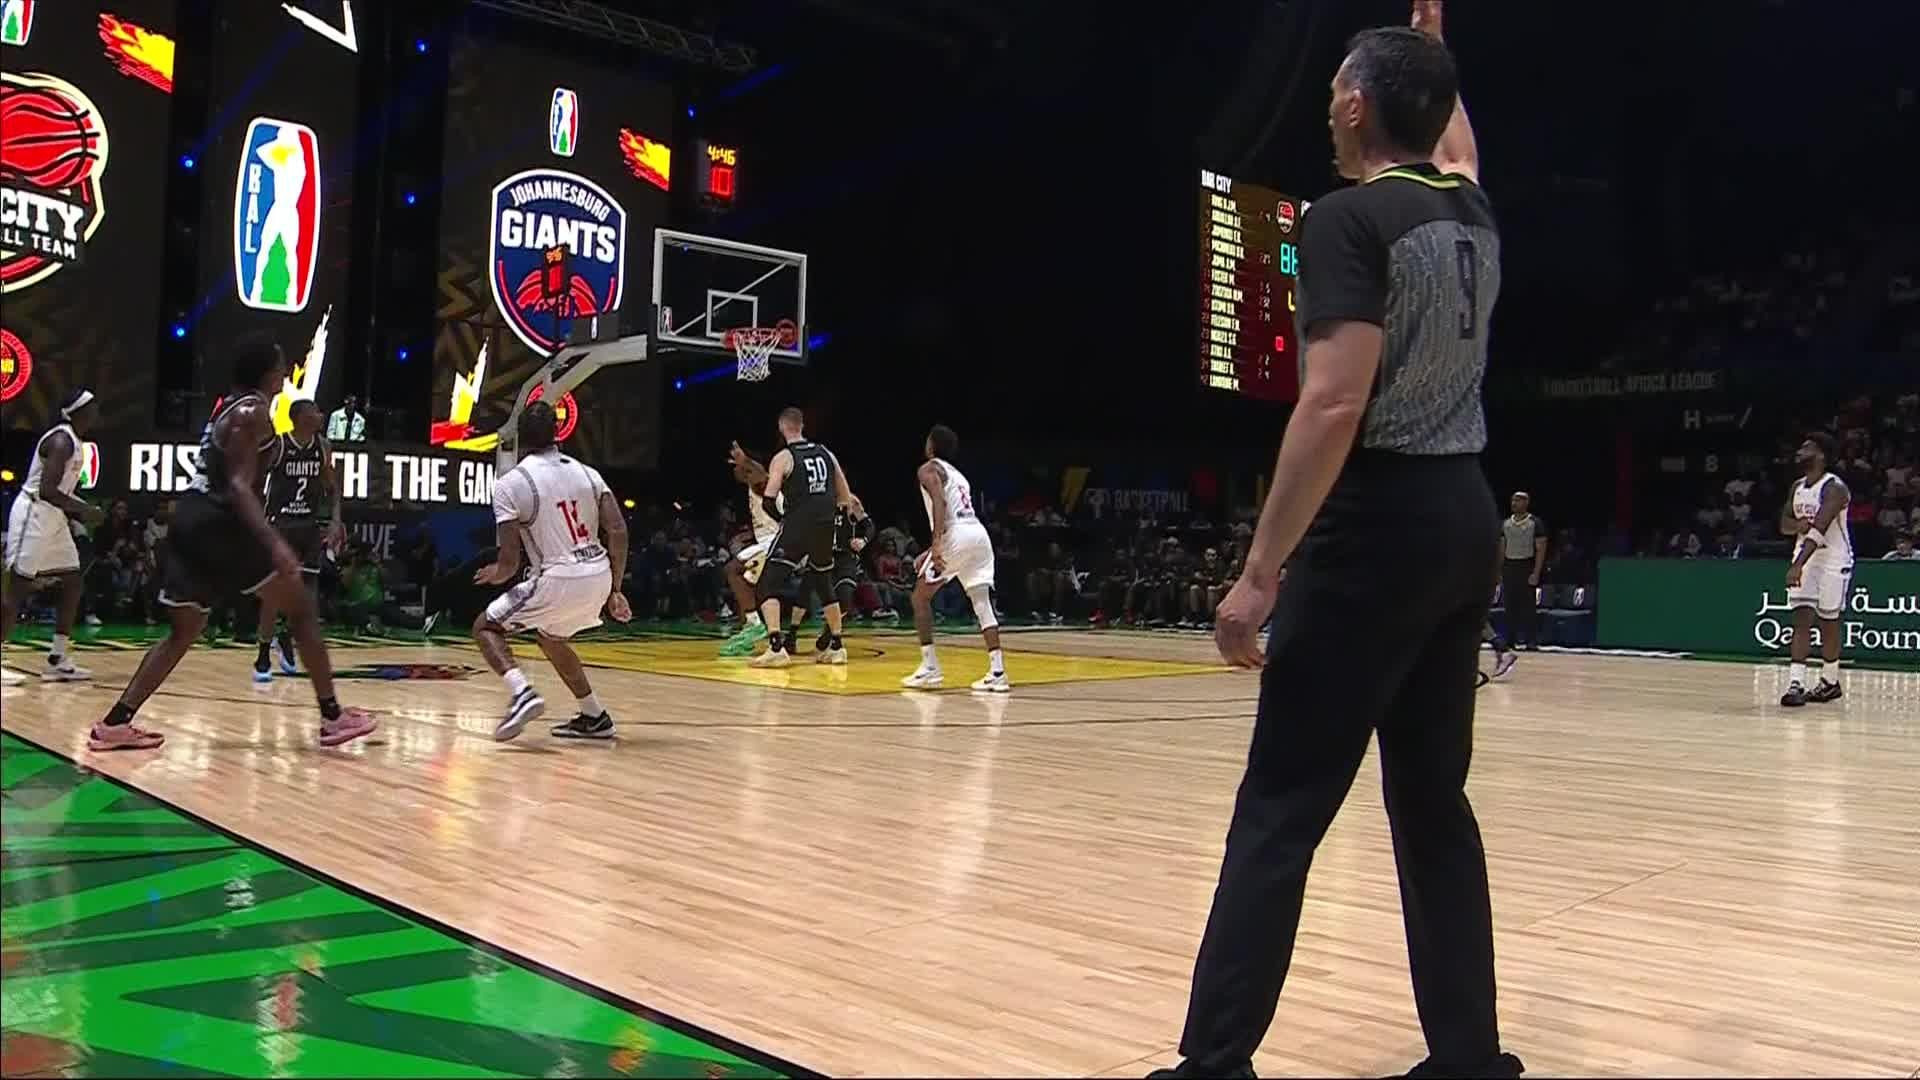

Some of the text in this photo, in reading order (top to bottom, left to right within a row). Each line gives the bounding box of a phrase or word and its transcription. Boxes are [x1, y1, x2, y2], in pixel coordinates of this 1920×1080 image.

[707, 144, 737, 167] 4:46
[0, 187, 84, 242] CITY
[245, 163, 262, 254] BAL
[509, 179, 611, 222] JOHANNESBURG
[0, 227, 77, 260] LL TEAM
[501, 208, 617, 264] GIANTS
[1454, 239, 1477, 340] 9
[129, 443, 202, 492] RIS
[384, 454, 449, 503] THE
[458, 460, 497, 505] GAM
[285, 461, 321, 476] GIANTS
[294, 477, 309, 498] 2
[804, 457, 828, 483] 50
[1754, 618, 1824, 649] Qaa
